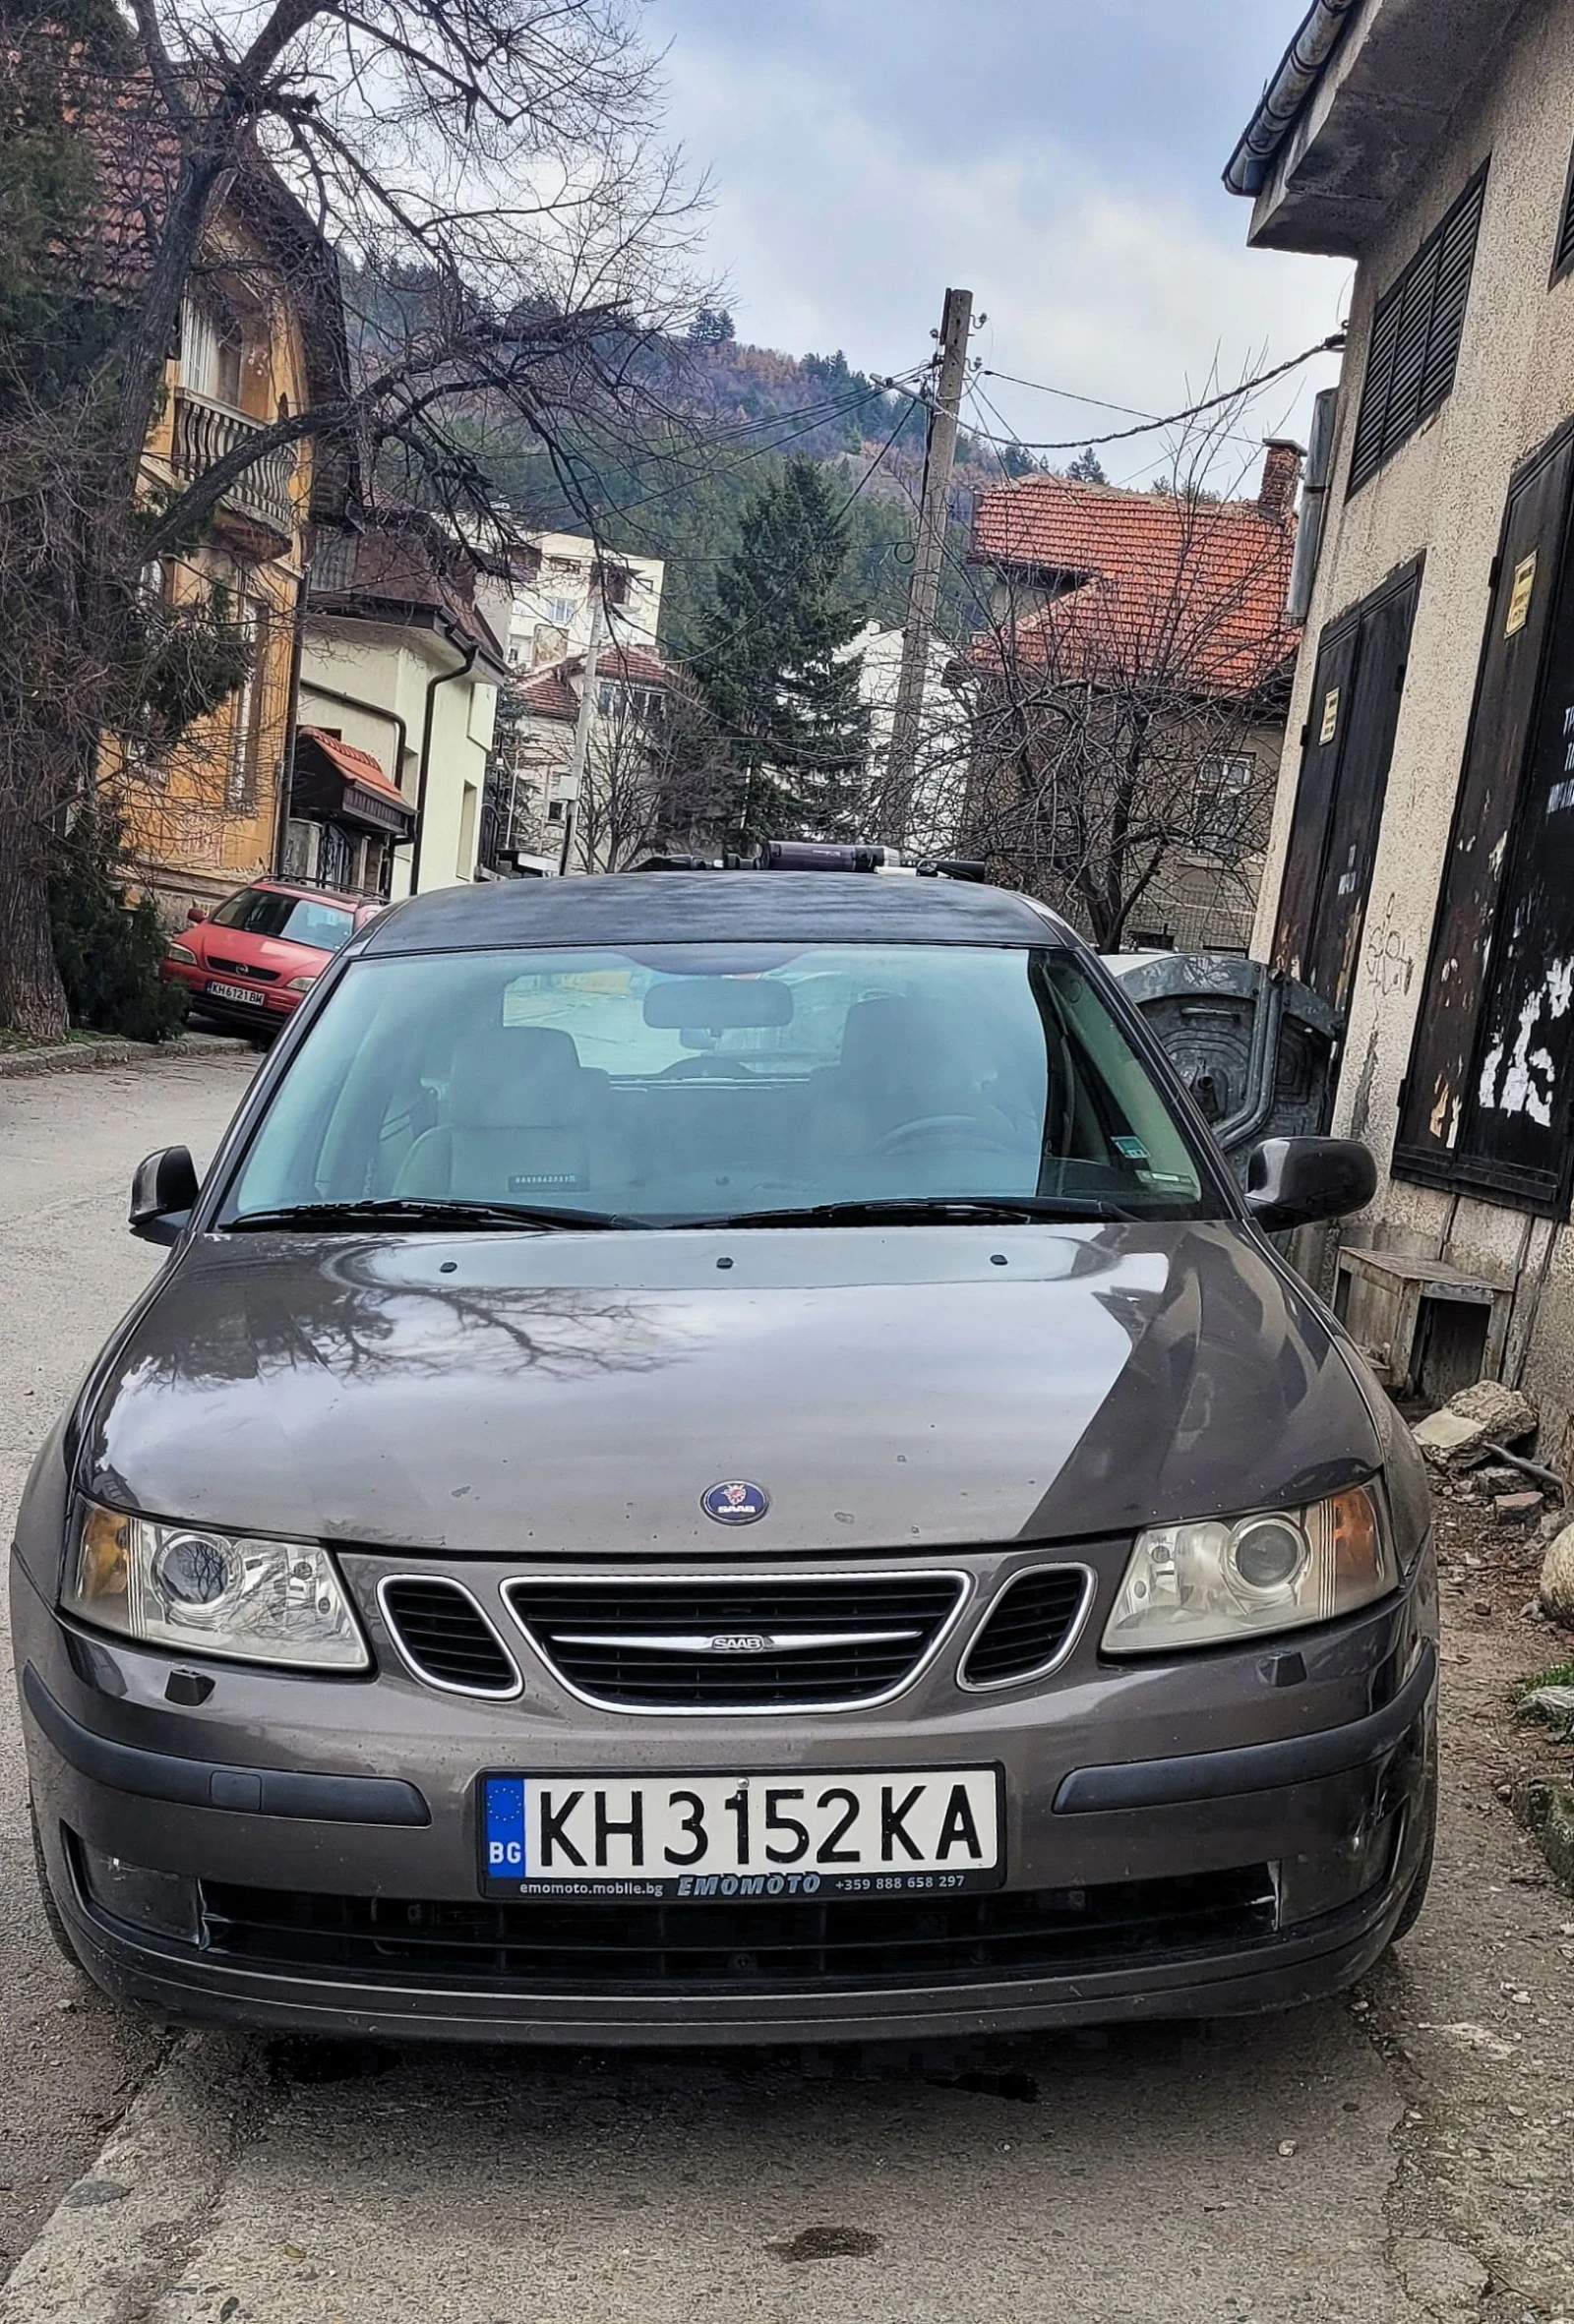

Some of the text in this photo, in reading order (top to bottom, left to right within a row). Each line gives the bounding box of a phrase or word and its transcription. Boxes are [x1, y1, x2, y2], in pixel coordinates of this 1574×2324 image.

[717, 1505, 757, 1514] SAAB
[713, 1638, 762, 1650] SAAB
[488, 1841, 522, 1865] BG
[676, 1874, 821, 1897] EMOMOTO
[835, 1879, 871, 1892] +359
[875, 1877, 903, 1890] 888
[906, 1877, 935, 1889] 658
[938, 1875, 966, 1887] 297
